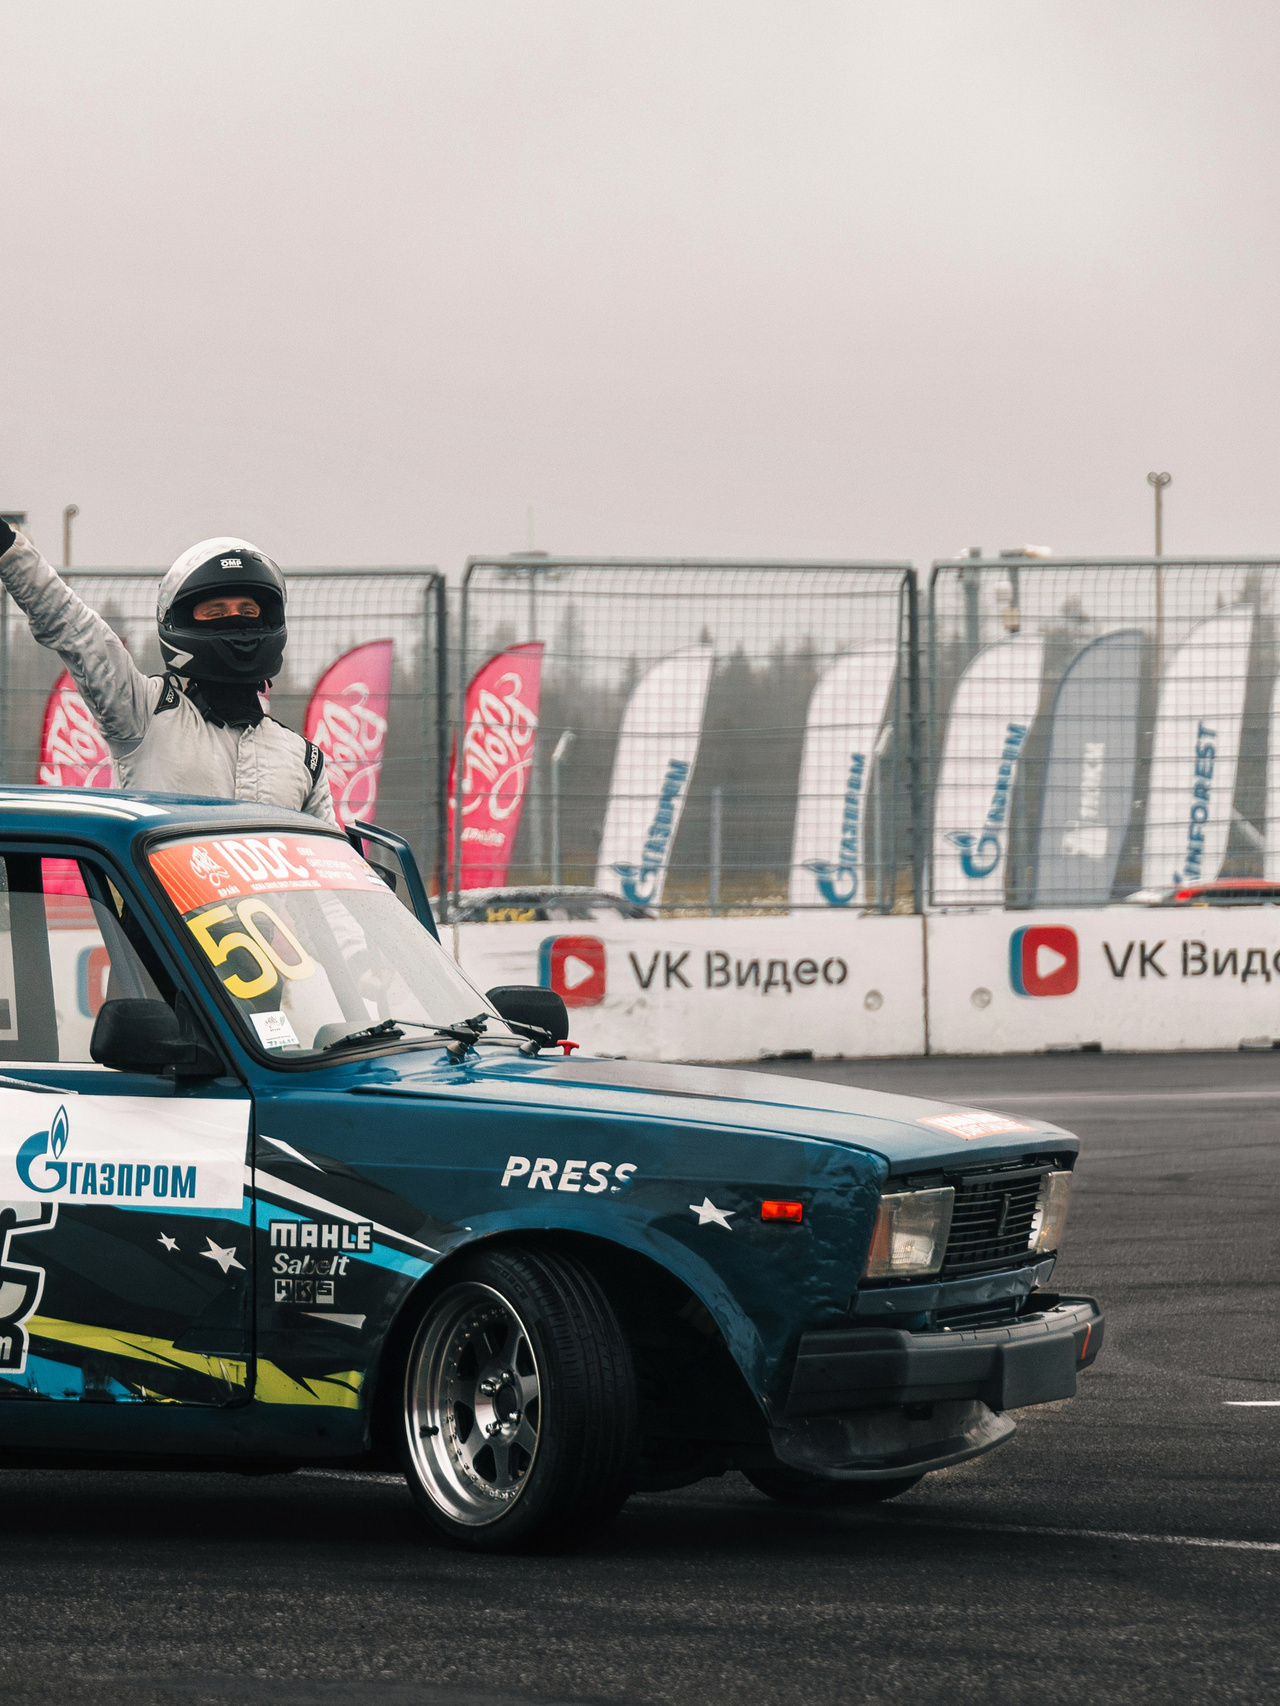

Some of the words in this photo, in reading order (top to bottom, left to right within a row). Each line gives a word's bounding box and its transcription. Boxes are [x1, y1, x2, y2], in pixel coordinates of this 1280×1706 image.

[220, 558, 242, 568] OMP
[212, 837, 310, 883] IDDC
[186, 898, 315, 999] 50
[1102, 939, 1168, 979] VK
[628, 949, 692, 989] VK
[705, 949, 849, 996] Видео
[69, 1161, 197, 1199] ГАЗПРОМ
[500, 1155, 638, 1194] PRESS
[270, 1222, 371, 1250] MAHLE
